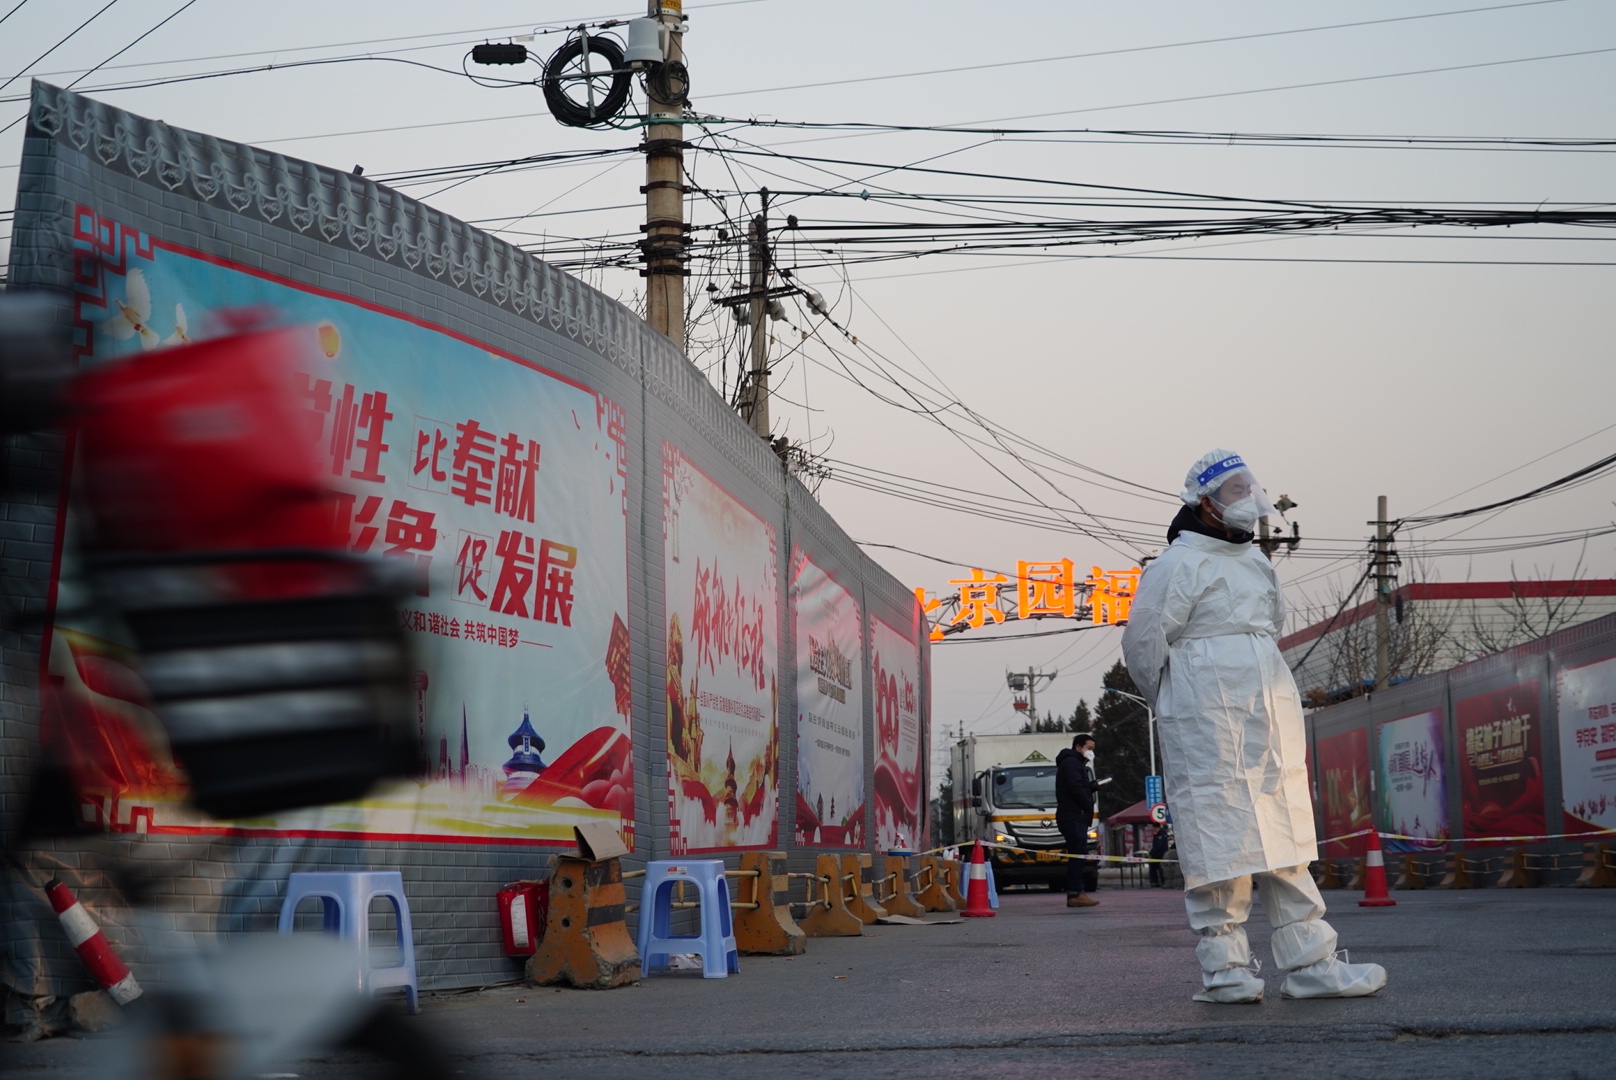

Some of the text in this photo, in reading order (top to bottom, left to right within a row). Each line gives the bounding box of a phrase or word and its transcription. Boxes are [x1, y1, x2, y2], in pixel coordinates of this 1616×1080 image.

[413, 418, 541, 523] 比奉献
[456, 530, 578, 627] 促发展
[394, 608, 460, 638] 义和谐社会
[1156, 808, 1165, 820] 5
